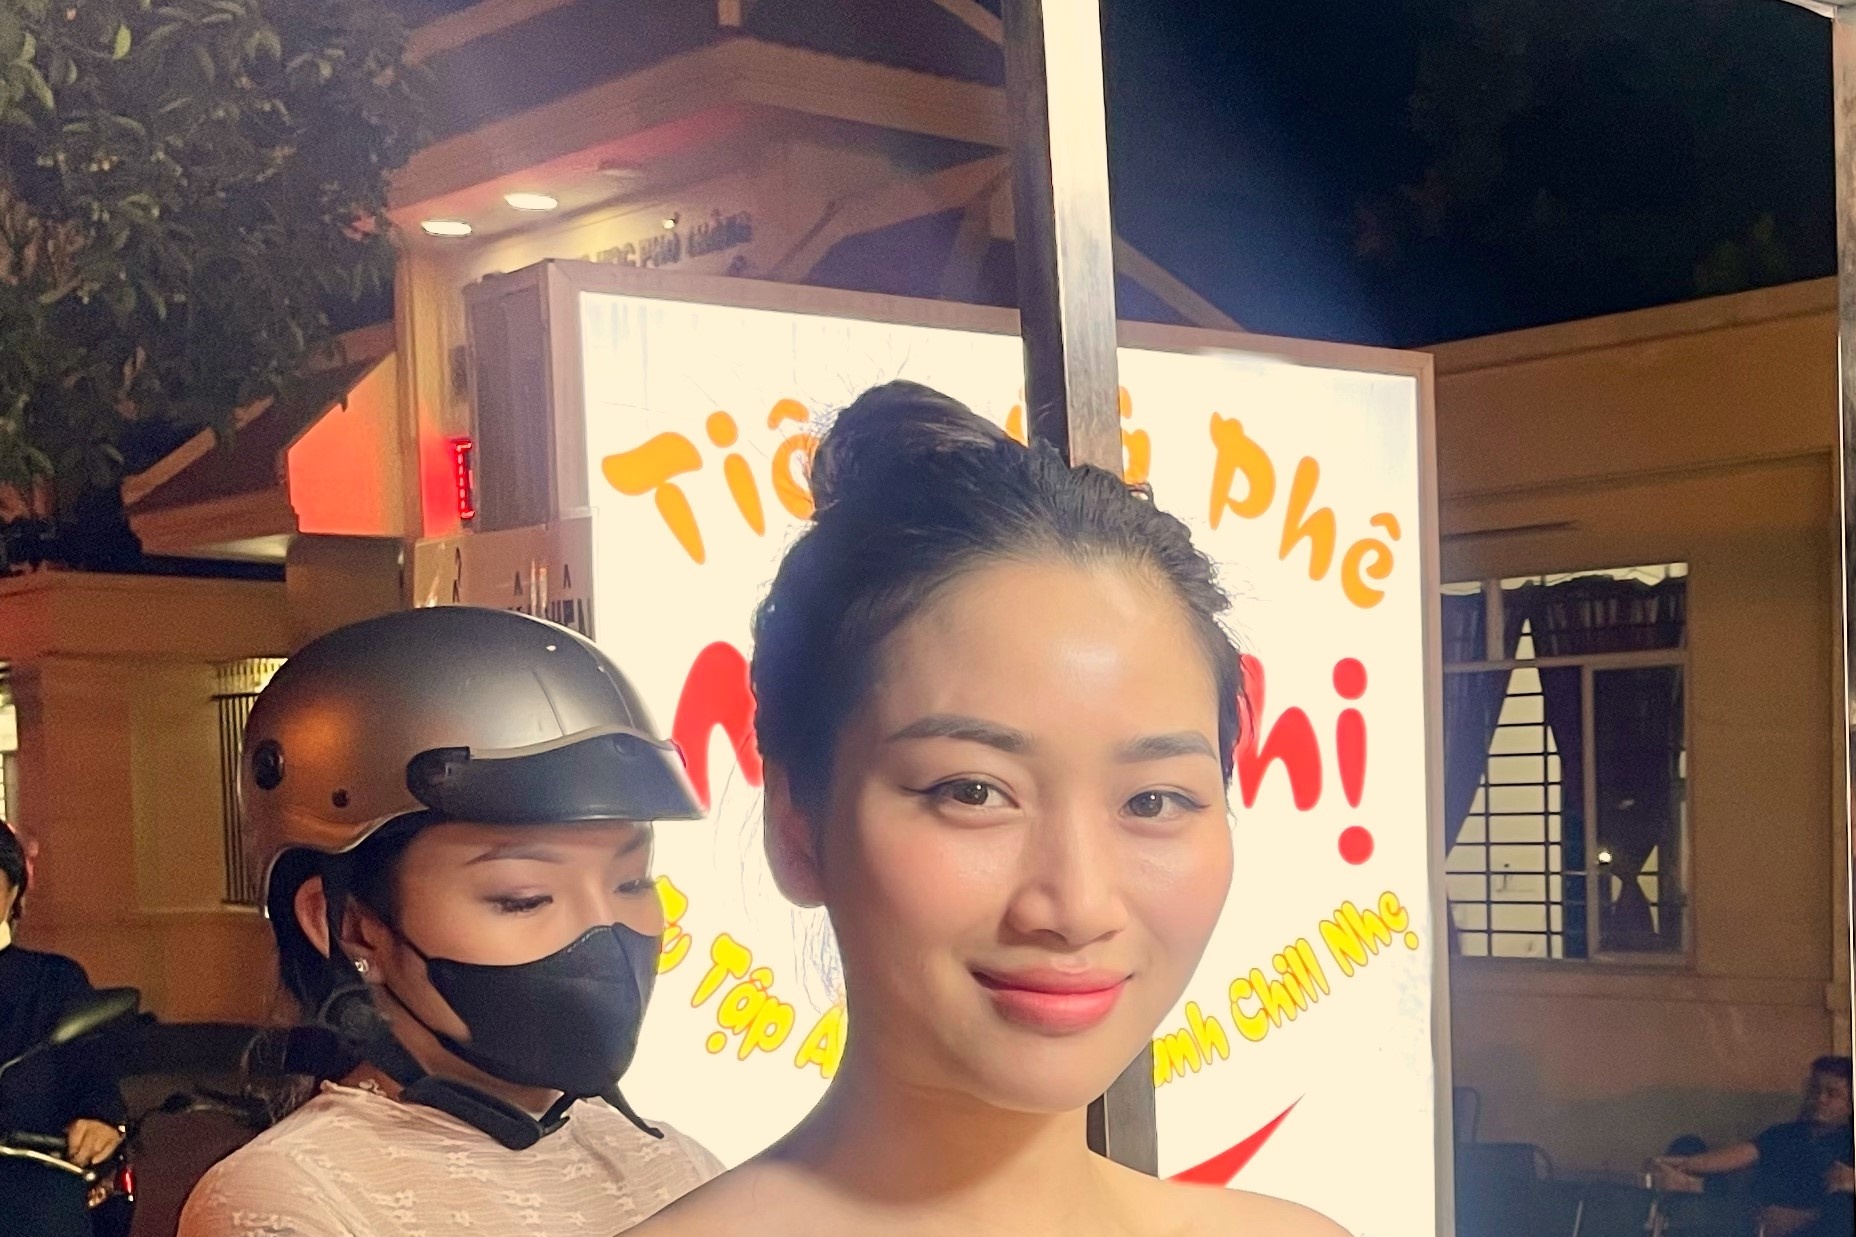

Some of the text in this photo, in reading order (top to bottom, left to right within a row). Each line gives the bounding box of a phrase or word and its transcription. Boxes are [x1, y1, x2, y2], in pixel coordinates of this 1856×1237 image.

[1208, 411, 1402, 610] Phê
[690, 932, 796, 1061] Tập
[1228, 966, 1331, 1042] Chill
[1318, 890, 1420, 978] Nhẹ
